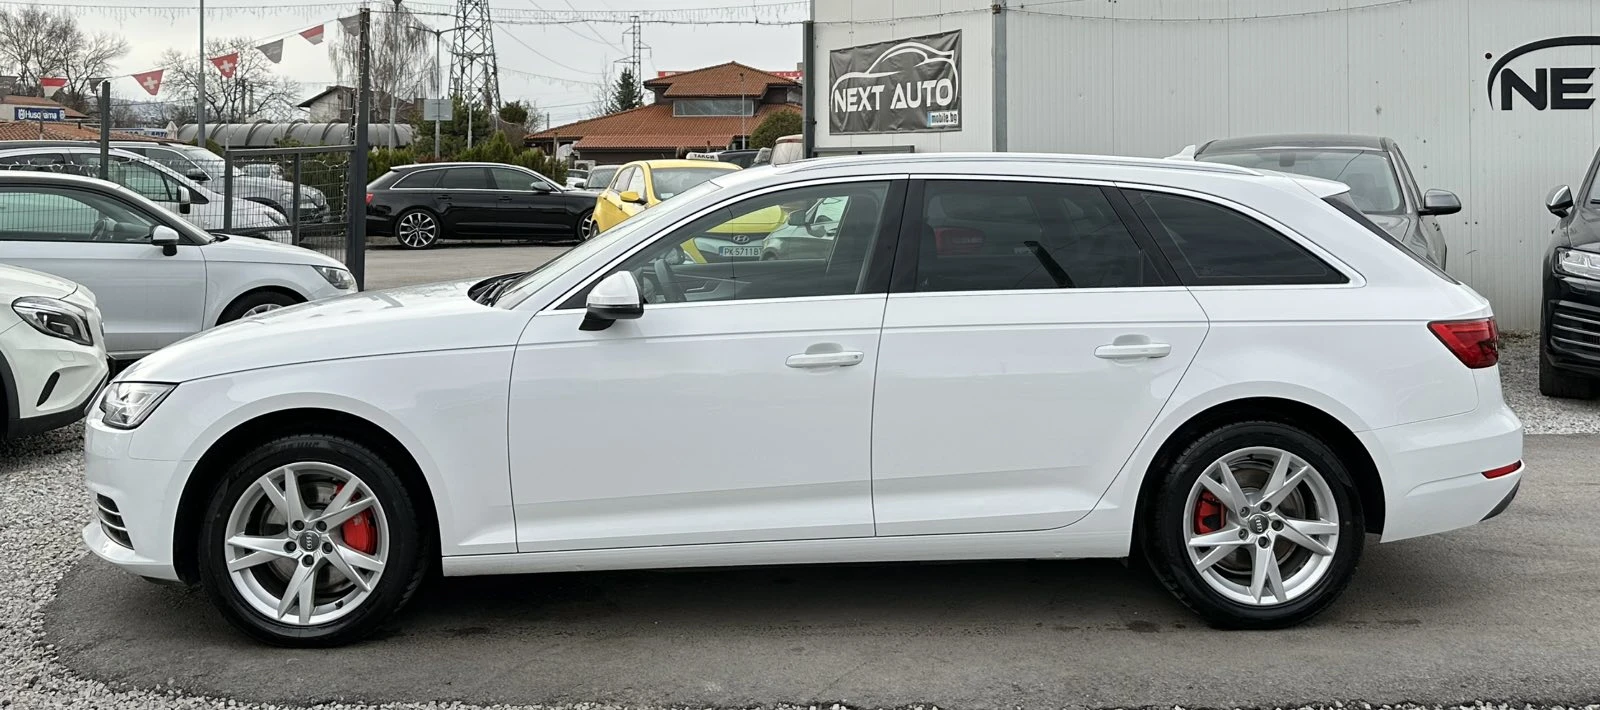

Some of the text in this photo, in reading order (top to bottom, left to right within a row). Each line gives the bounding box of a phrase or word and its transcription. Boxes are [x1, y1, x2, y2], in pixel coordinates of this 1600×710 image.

[834, 78, 953, 113] NEXT AUTO
[1500, 67, 1600, 111] NE
[25, 109, 57, 120] Husqarna
[931, 111, 958, 124] mobile.bg
